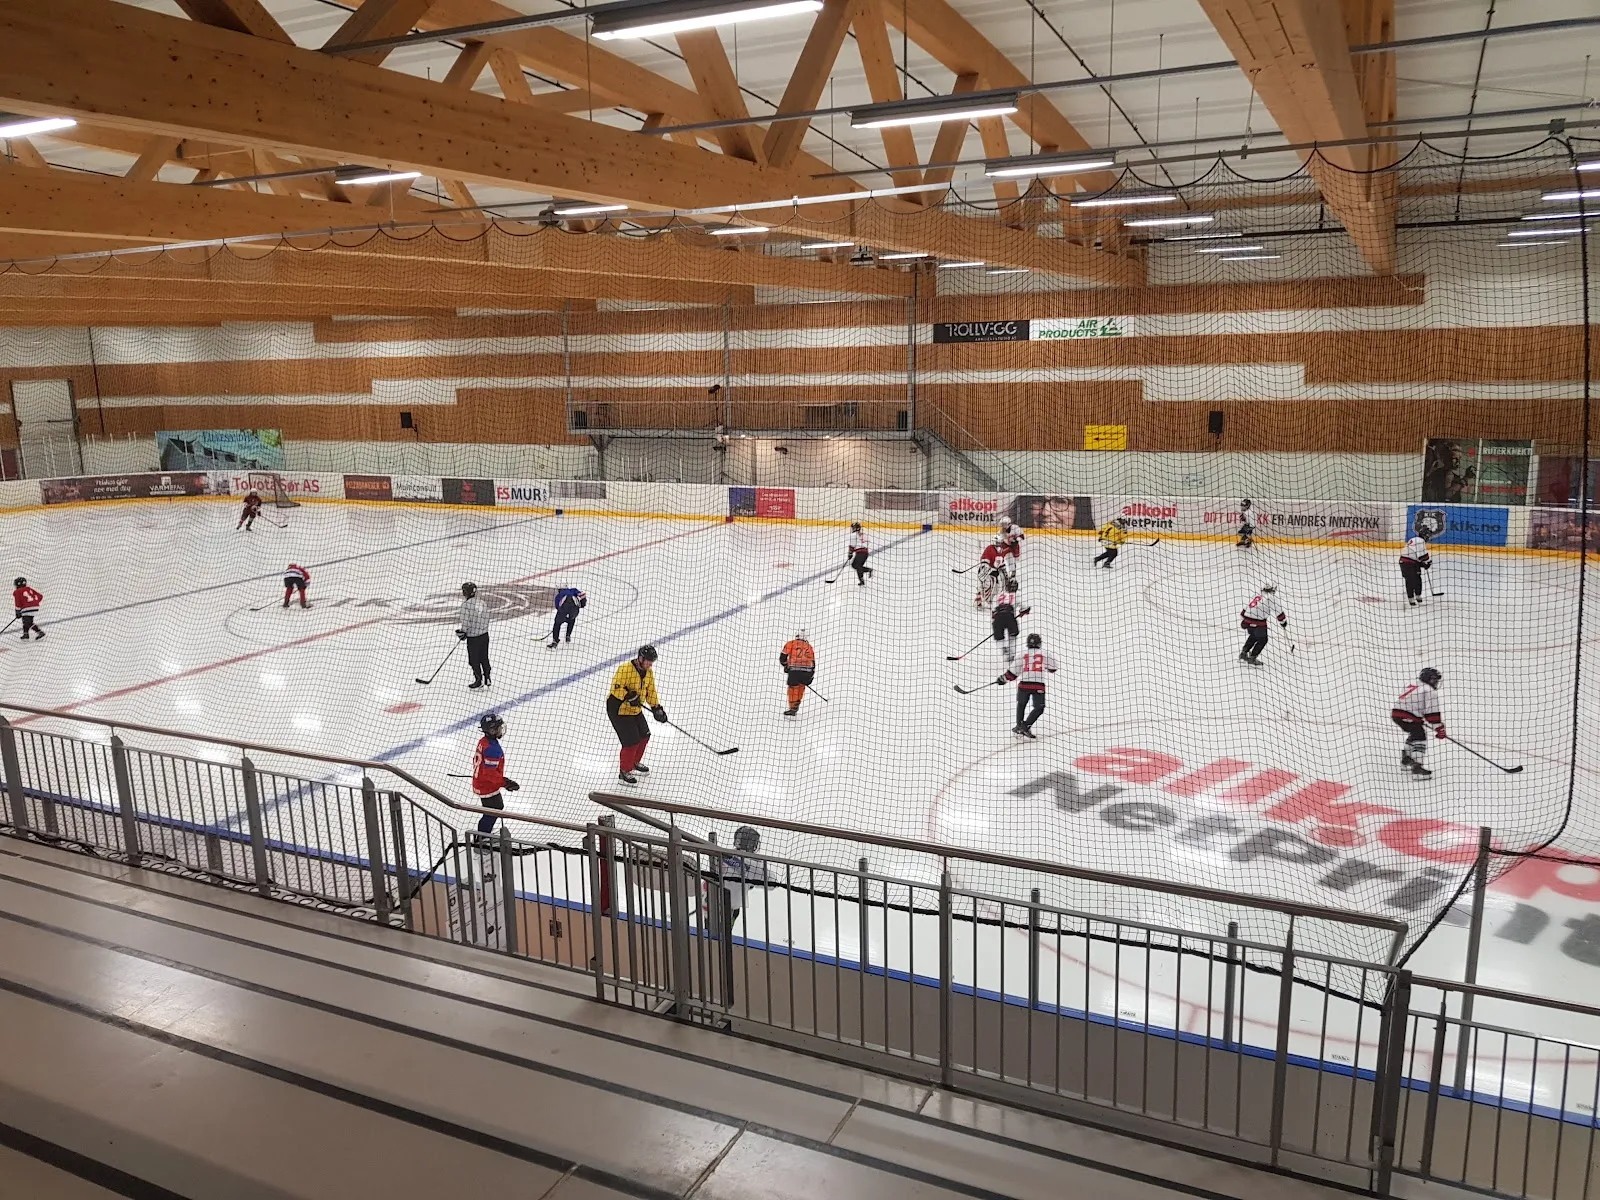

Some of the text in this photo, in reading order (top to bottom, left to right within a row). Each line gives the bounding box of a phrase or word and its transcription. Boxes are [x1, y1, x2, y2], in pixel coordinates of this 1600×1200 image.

[945, 322, 1017, 337] TROLLVEGG
[1077, 319, 1098, 329] AIR
[1038, 328, 1098, 338] PRODUCTS
[303, 479, 320, 493] AS
[949, 498, 998, 514] allkopi
[1121, 503, 1178, 519] allkopi
[949, 512, 995, 521] NetPrint
[1124, 517, 1173, 528] NetPrint
[1272, 513, 1284, 525] ER
[1287, 514, 1327, 527] ANDRES
[1328, 516, 1380, 529] INNTRYKK
[1450, 520, 1501, 533] kik.no
[1023, 653, 1043, 672] 12
